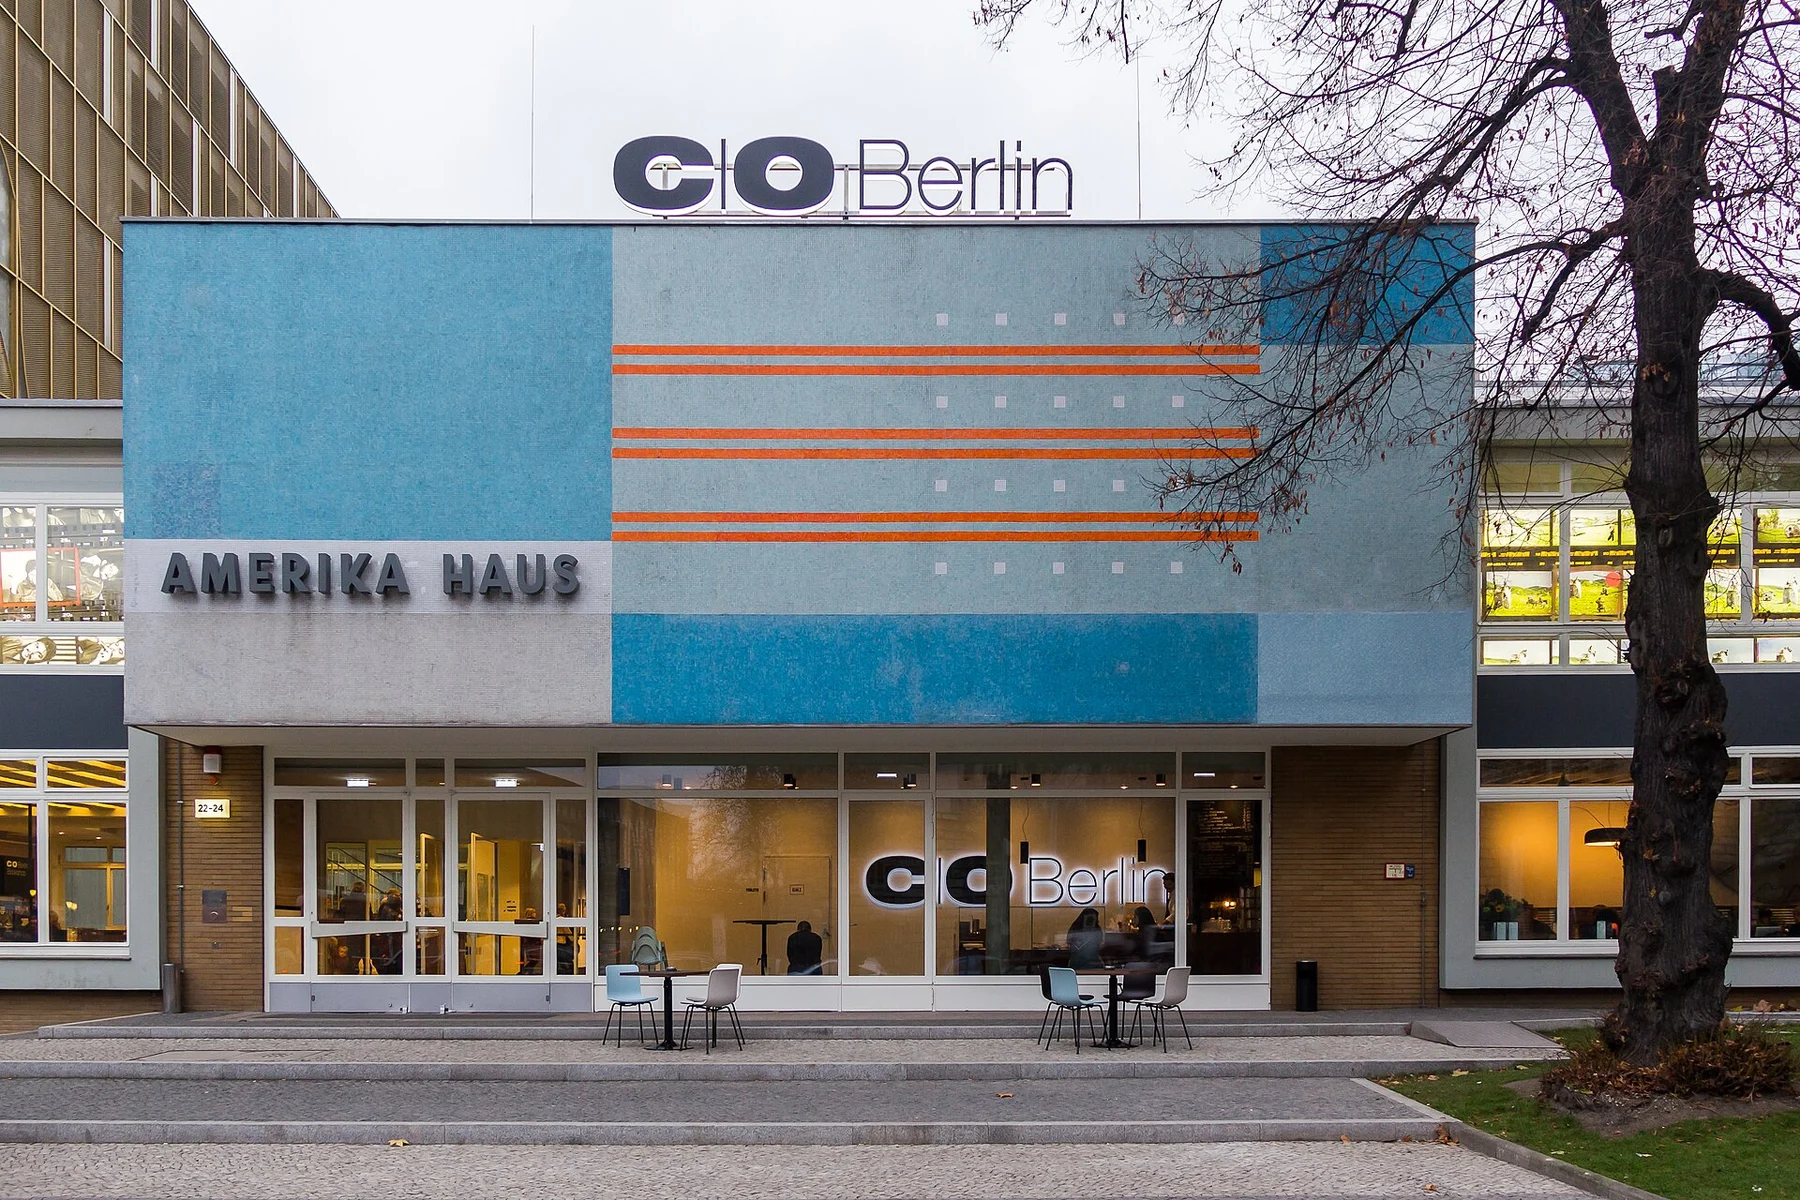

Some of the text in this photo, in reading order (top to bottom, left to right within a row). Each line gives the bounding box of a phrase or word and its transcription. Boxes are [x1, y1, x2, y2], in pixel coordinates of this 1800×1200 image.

[858, 138, 1073, 215] Berlin
[161, 552, 580, 595] AMERIKA HAUS
[198, 804, 223, 813] 22-24
[1028, 856, 1167, 905] Berlin
